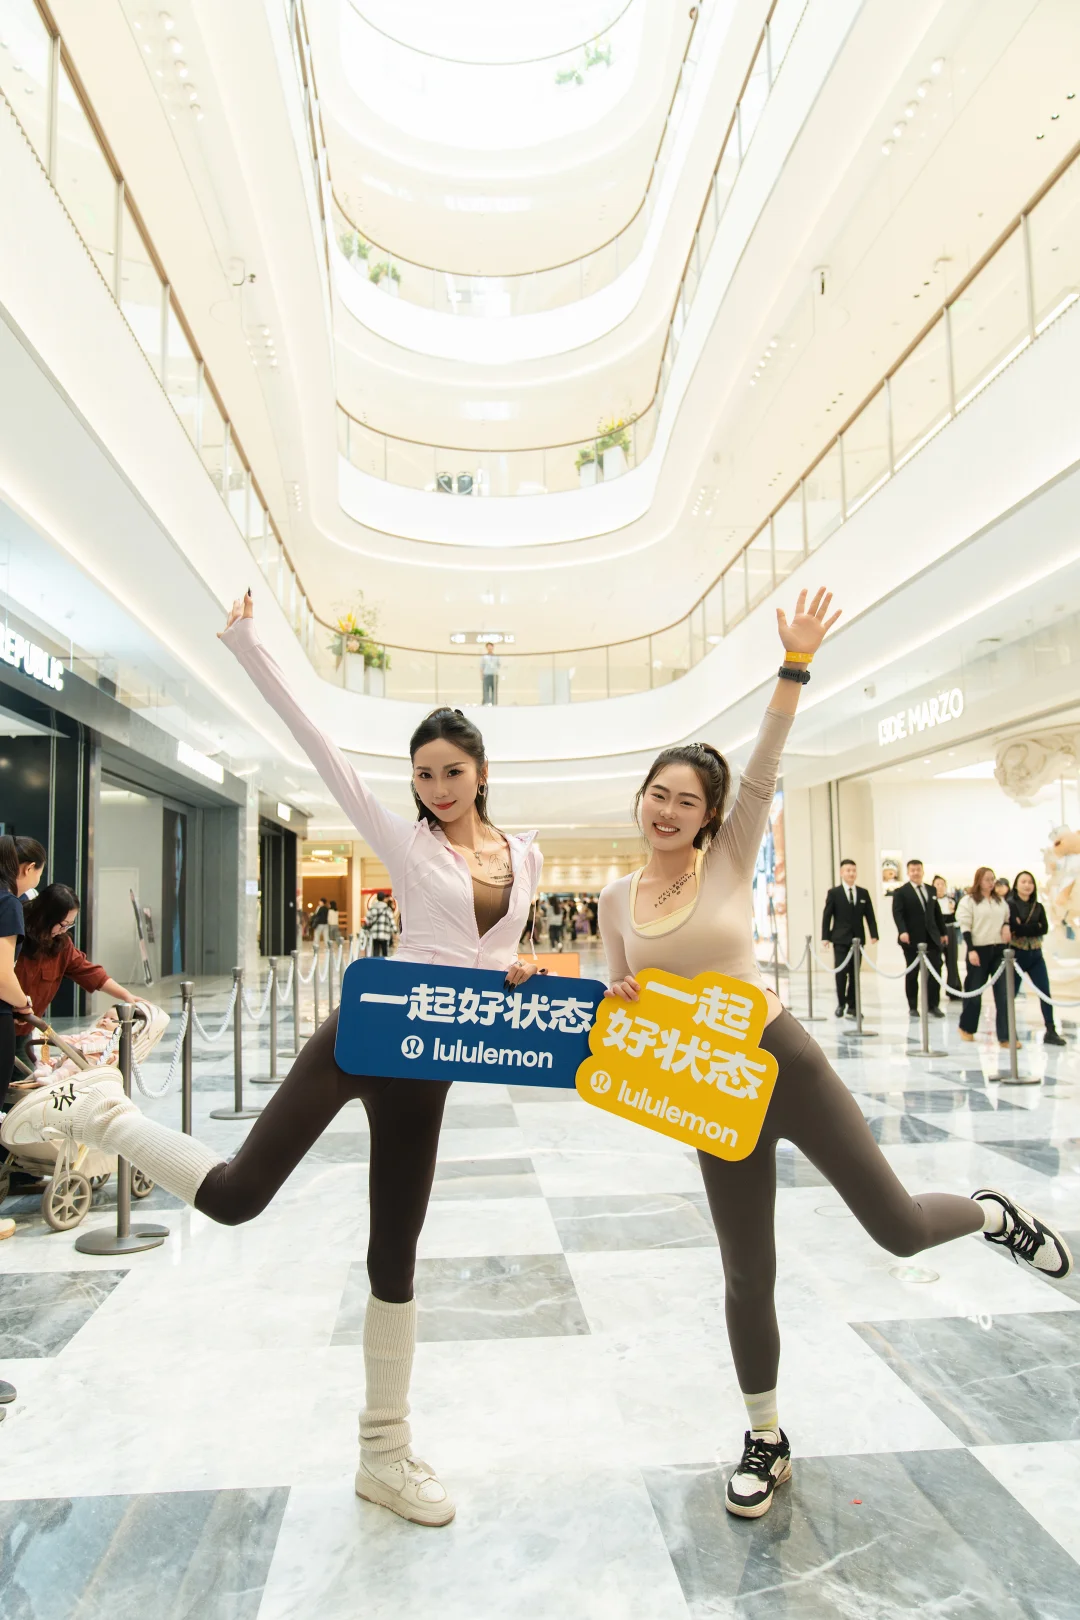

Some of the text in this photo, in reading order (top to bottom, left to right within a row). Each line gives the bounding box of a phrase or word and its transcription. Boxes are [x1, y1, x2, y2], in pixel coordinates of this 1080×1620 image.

[908, 688, 964, 735] MARZO
[654, 872, 696, 909] PLAYGROUND
[360, 983, 594, 1034] 一起好状态
[646, 981, 753, 1041] 一起
[433, 1038, 553, 1069] lululemon
[602, 1008, 767, 1100] 好状态
[617, 1080, 738, 1148] lululemon
